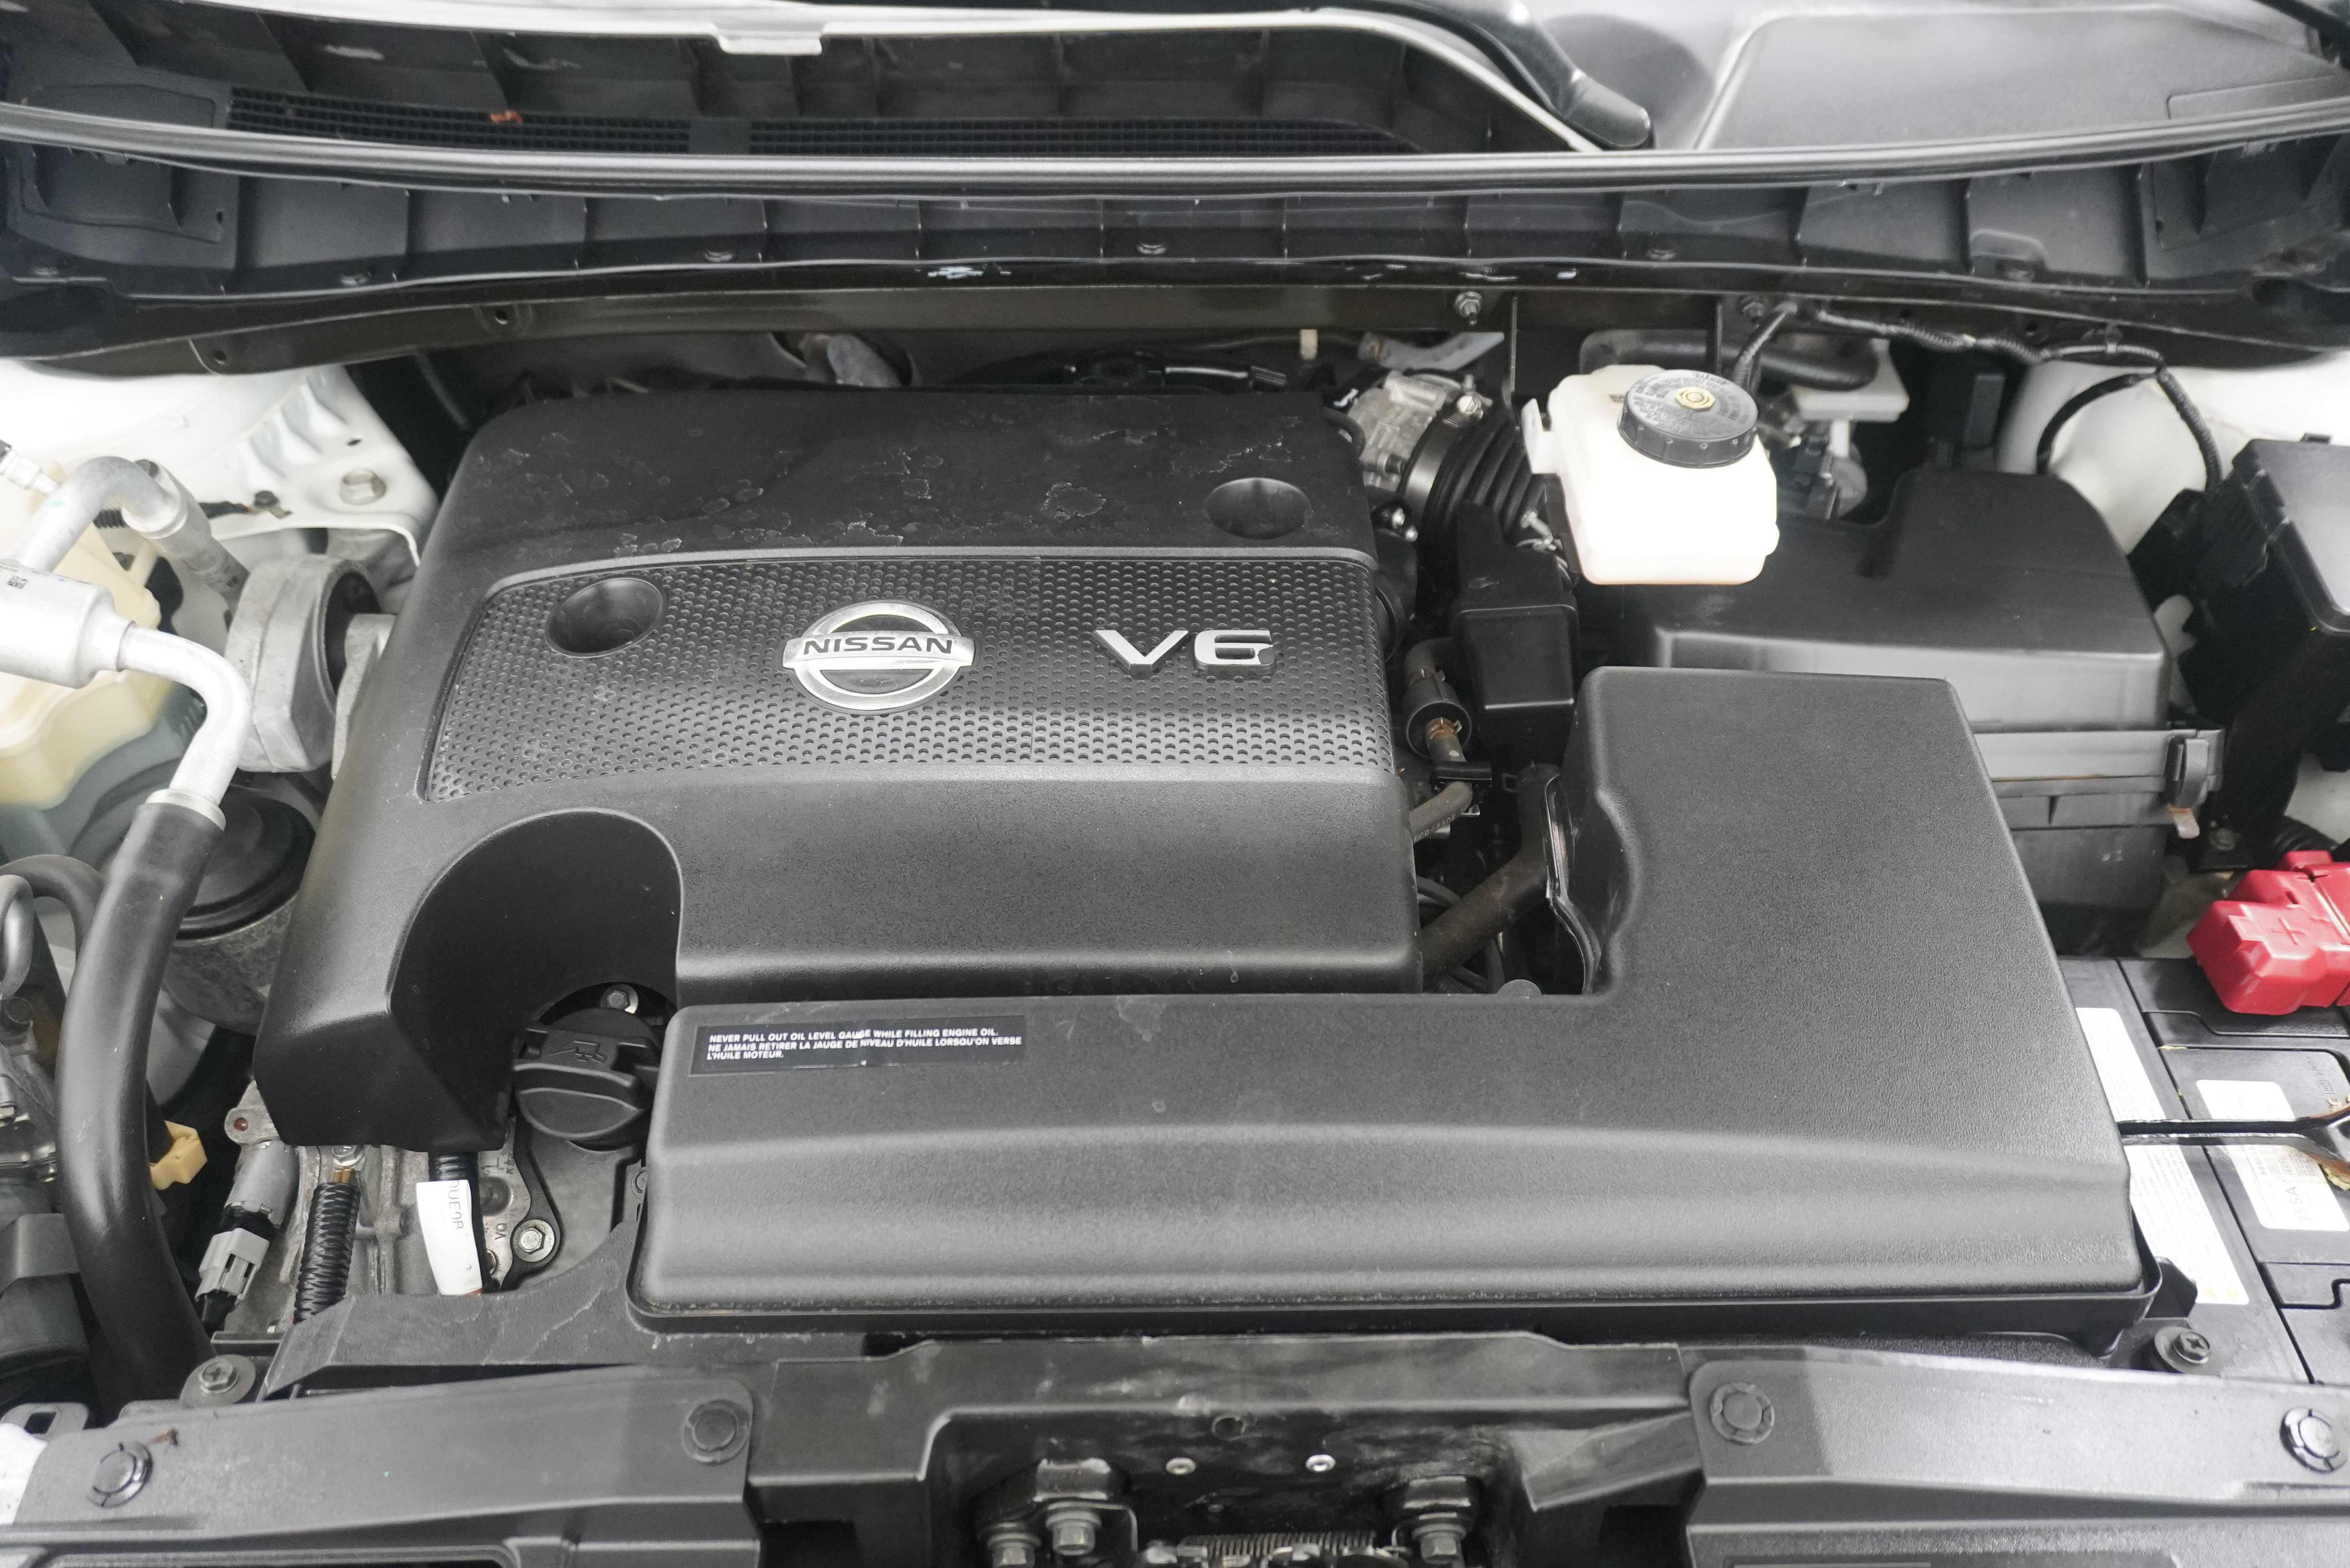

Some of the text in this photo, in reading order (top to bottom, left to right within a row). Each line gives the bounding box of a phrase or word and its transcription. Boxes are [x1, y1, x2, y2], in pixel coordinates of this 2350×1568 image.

[803, 637, 952, 655] NISSAN
[1093, 629, 1275, 675] V6
[709, 1028, 999, 1043] NEVER PULL OUT OIL LEVEL GAUGE WHILE FILLING ENGINE OIL.
[708, 1036, 1022, 1052] NE JAMAIS RETIRER LA JAUGE DE NIVEAU D'HUILE LORSQU'ON VERSE
[707, 1050, 784, 1060] L'HUILE MOTEUR.
